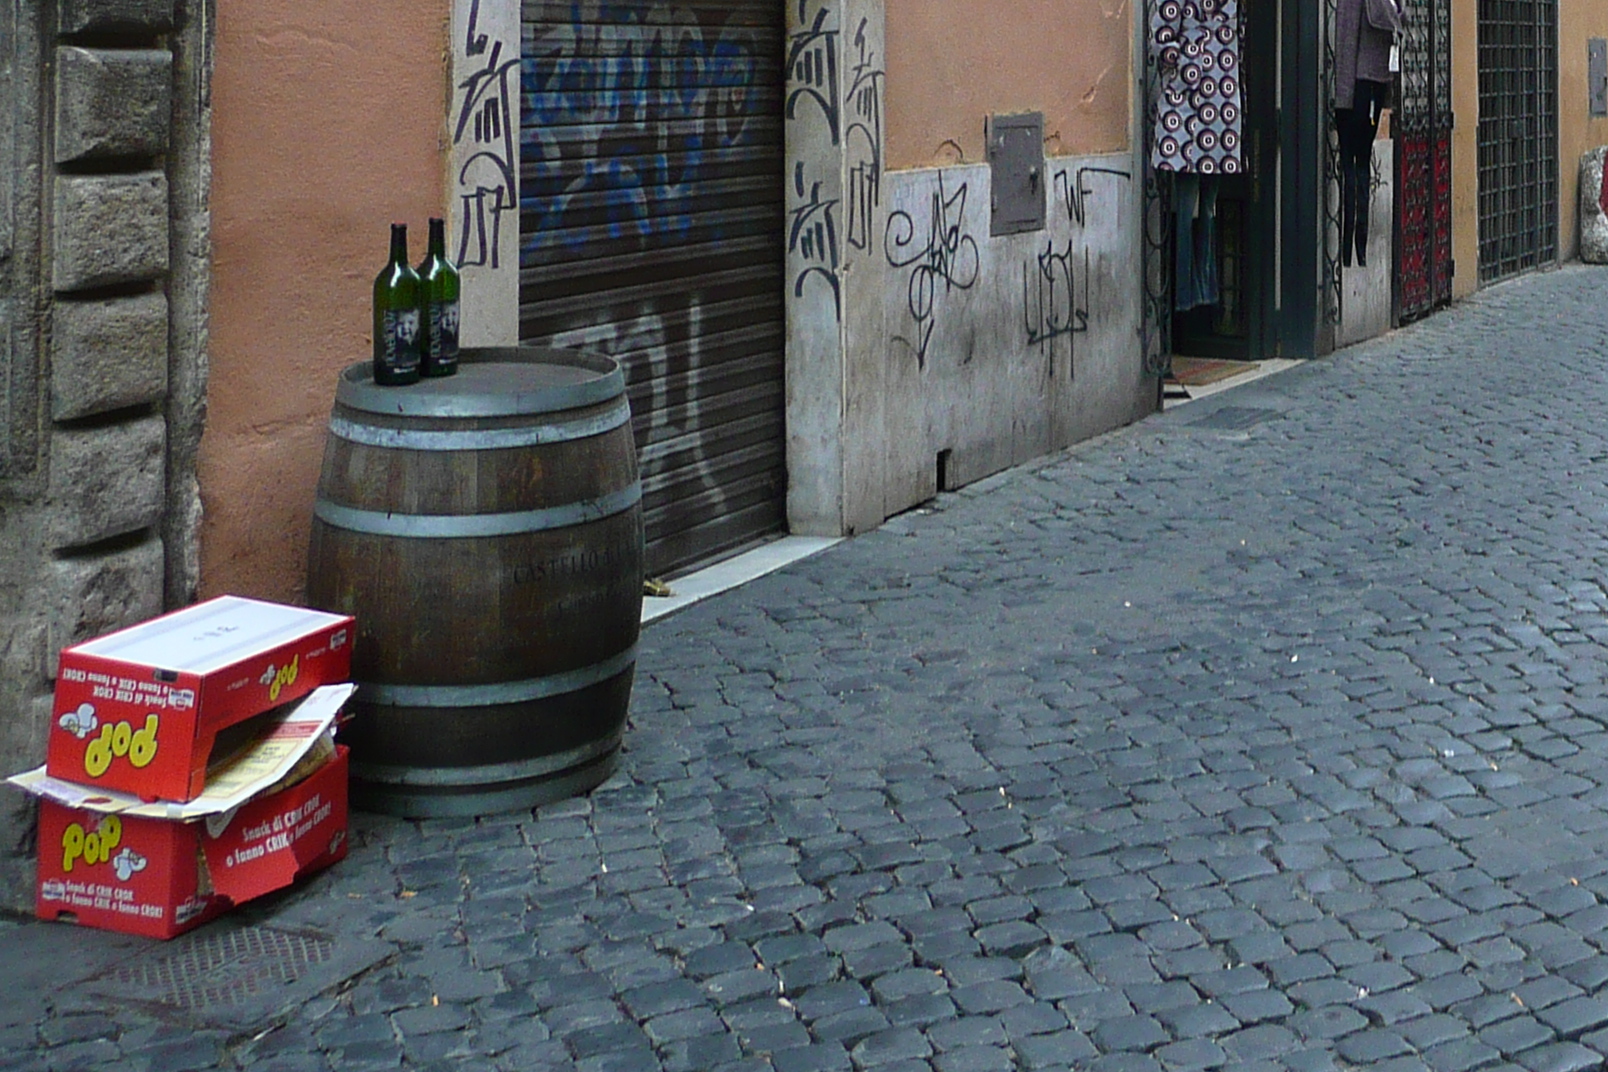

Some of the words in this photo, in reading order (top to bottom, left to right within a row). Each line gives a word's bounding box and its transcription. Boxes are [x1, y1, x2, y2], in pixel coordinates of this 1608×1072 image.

[119, 678, 137, 691] CRIK
[269, 652, 299, 702] POP
[93, 685, 113, 699] CROK
[114, 688, 133, 702] CRIK
[134, 691, 143, 704] di
[144, 693, 167, 708] Snack
[84, 713, 160, 778] POP
[242, 820, 272, 842] Snack
[273, 814, 283, 832] di
[283, 806, 302, 828] CRIK
[61, 813, 122, 874] POP
[226, 854, 234, 868] o
[235, 847, 265, 865] fanno
[265, 831, 289, 853] CRIK
